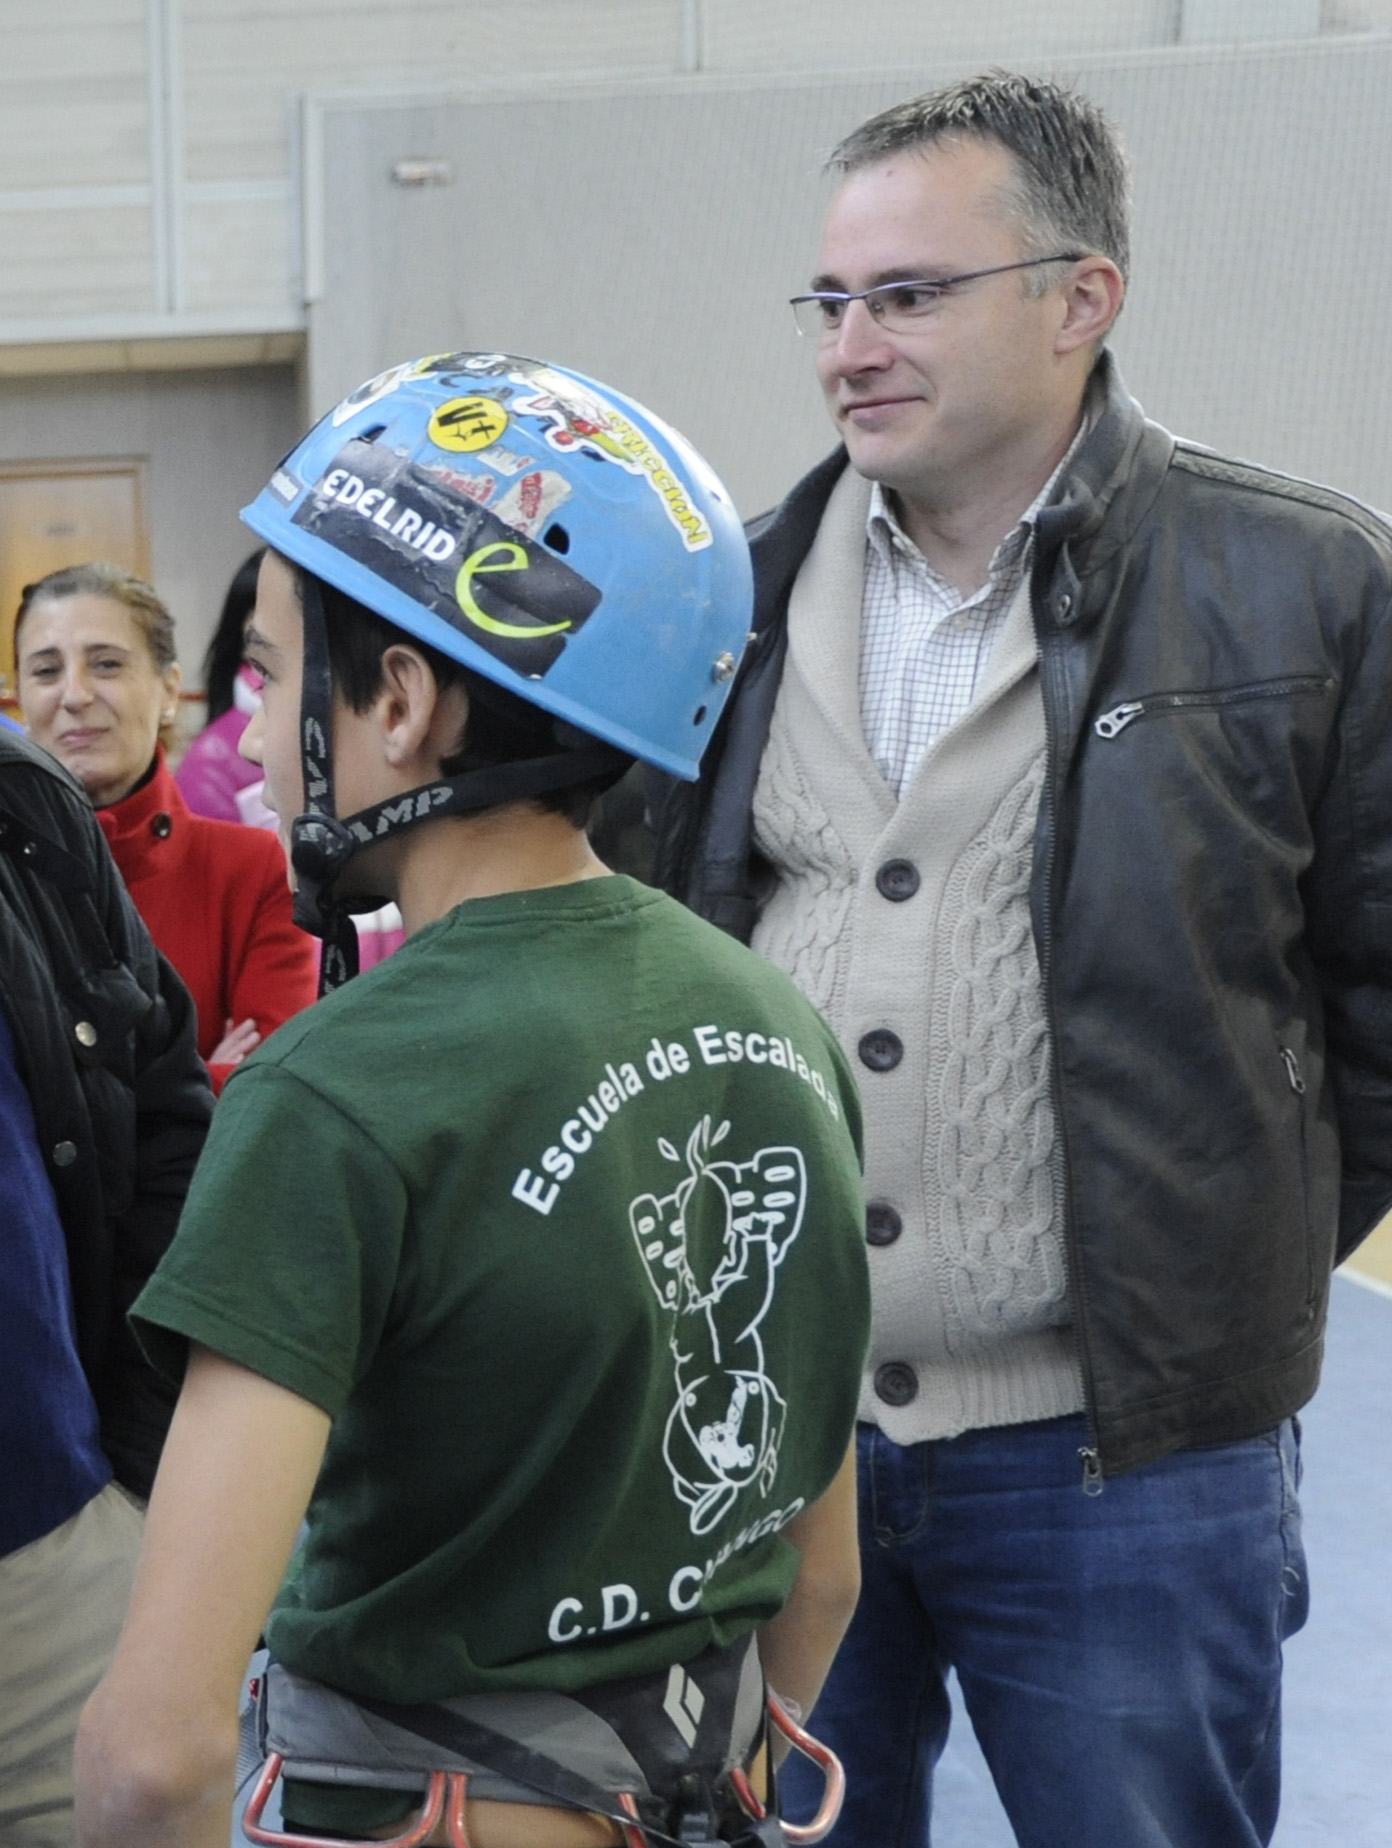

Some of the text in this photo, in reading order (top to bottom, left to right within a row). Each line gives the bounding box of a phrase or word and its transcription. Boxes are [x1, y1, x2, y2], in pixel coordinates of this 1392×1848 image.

[322, 469, 457, 561] EDELRID
[511, 1062, 645, 1215] Escuela
[646, 1037, 690, 1080] de
[548, 1583, 650, 1643] C.D.
